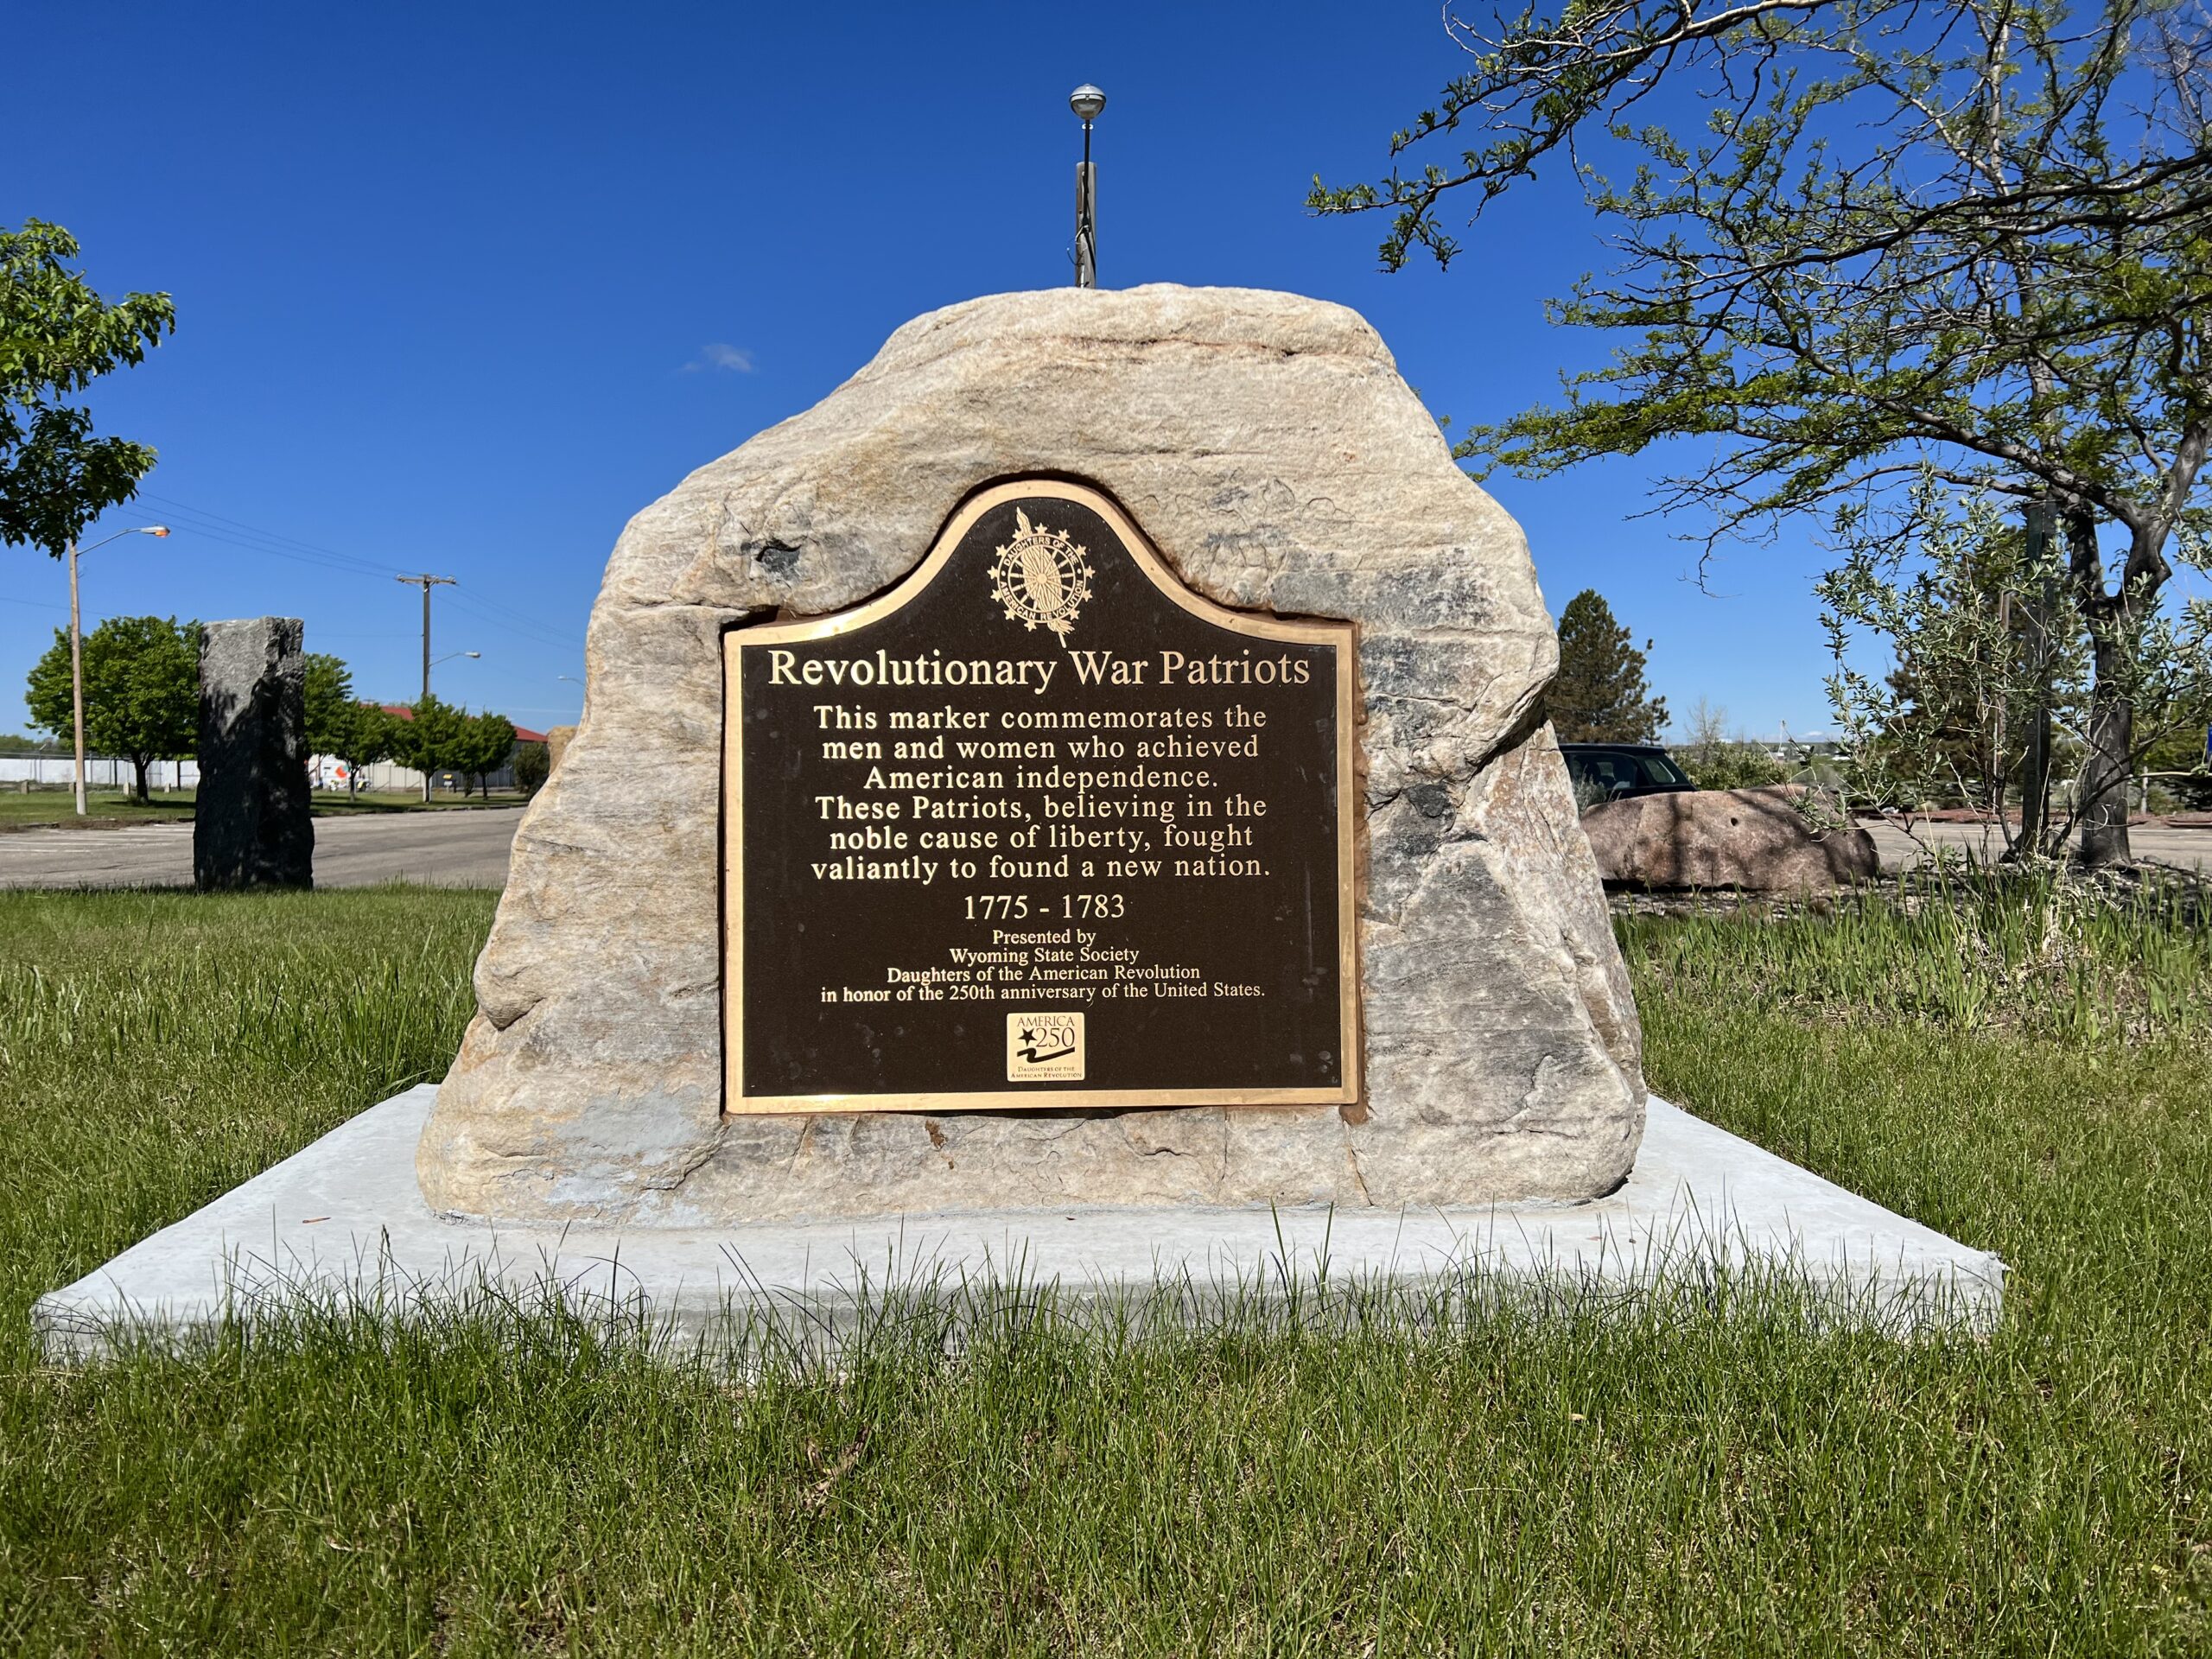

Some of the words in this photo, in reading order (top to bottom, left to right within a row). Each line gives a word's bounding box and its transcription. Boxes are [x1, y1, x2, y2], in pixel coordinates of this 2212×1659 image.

[1003, 537, 1051, 567] DAUGHTERS
[1052, 539, 1065, 551] OF
[1065, 548, 1079, 565] THE
[1000, 581, 1036, 620] AMERICAN
[1040, 579, 1084, 621] REVOLUTION
[767, 648, 1058, 695] Revolutionary
[1067, 650, 1149, 685] War
[1159, 649, 1310, 684] Patriots
[813, 704, 878, 730] This
[888, 704, 990, 729] marker
[1001, 708, 1213, 729] commemorates
[1224, 704, 1267, 728] the
[822, 741, 882, 760] men
[893, 734, 944, 760] and
[956, 741, 1056, 760] women
[1067, 734, 1125, 759] who
[1136, 734, 1259, 758] achieved
[862, 764, 1004, 790] American
[1016, 764, 1217, 795] independence.
[814, 794, 900, 820] These
[912, 794, 1032, 823] Patriots,
[1043, 793, 1175, 823] believing
[1186, 793, 1213, 817] in
[1224, 793, 1267, 817] the
[830, 824, 908, 850] noble
[919, 831, 998, 849] cause
[1009, 823, 1041, 849] of
[1049, 823, 1151, 854] liberty,
[1163, 823, 1253, 853] fought
[810, 855, 939, 886] valiantly
[949, 858, 976, 879] to
[988, 854, 1070, 879] found
[1081, 861, 1095, 878] a
[1106, 861, 1162, 877] new
[1173, 855, 1270, 876] nation.
[964, 894, 1028, 920] 1775
[1062, 893, 1125, 918] 1783
[992, 928, 1071, 944] Presented
[1076, 928, 1096, 948] by
[949, 947, 1029, 966] Wyoming
[1033, 947, 1074, 963] State
[1079, 944, 1140, 965] Society
[887, 966, 971, 984] Daughters
[976, 965, 995, 982] of
[997, 965, 1023, 982] the
[1028, 964, 1109, 981] American
[1114, 963, 1201, 980] Revolution
[821, 986, 837, 1003] in
[842, 986, 892, 1002] honor
[896, 985, 916, 1001] of
[918, 984, 944, 1001] the
[949, 984, 995, 1001] 250th
[1001, 983, 1096, 1002] anniversary
[1102, 982, 1121, 998] of
[1123, 982, 1148, 998] the
[1154, 982, 1208, 998] United
[1213, 982, 1265, 997] States.
[1017, 1015, 1075, 1027] AMERICA
[1035, 1027, 1075, 1048] 250
